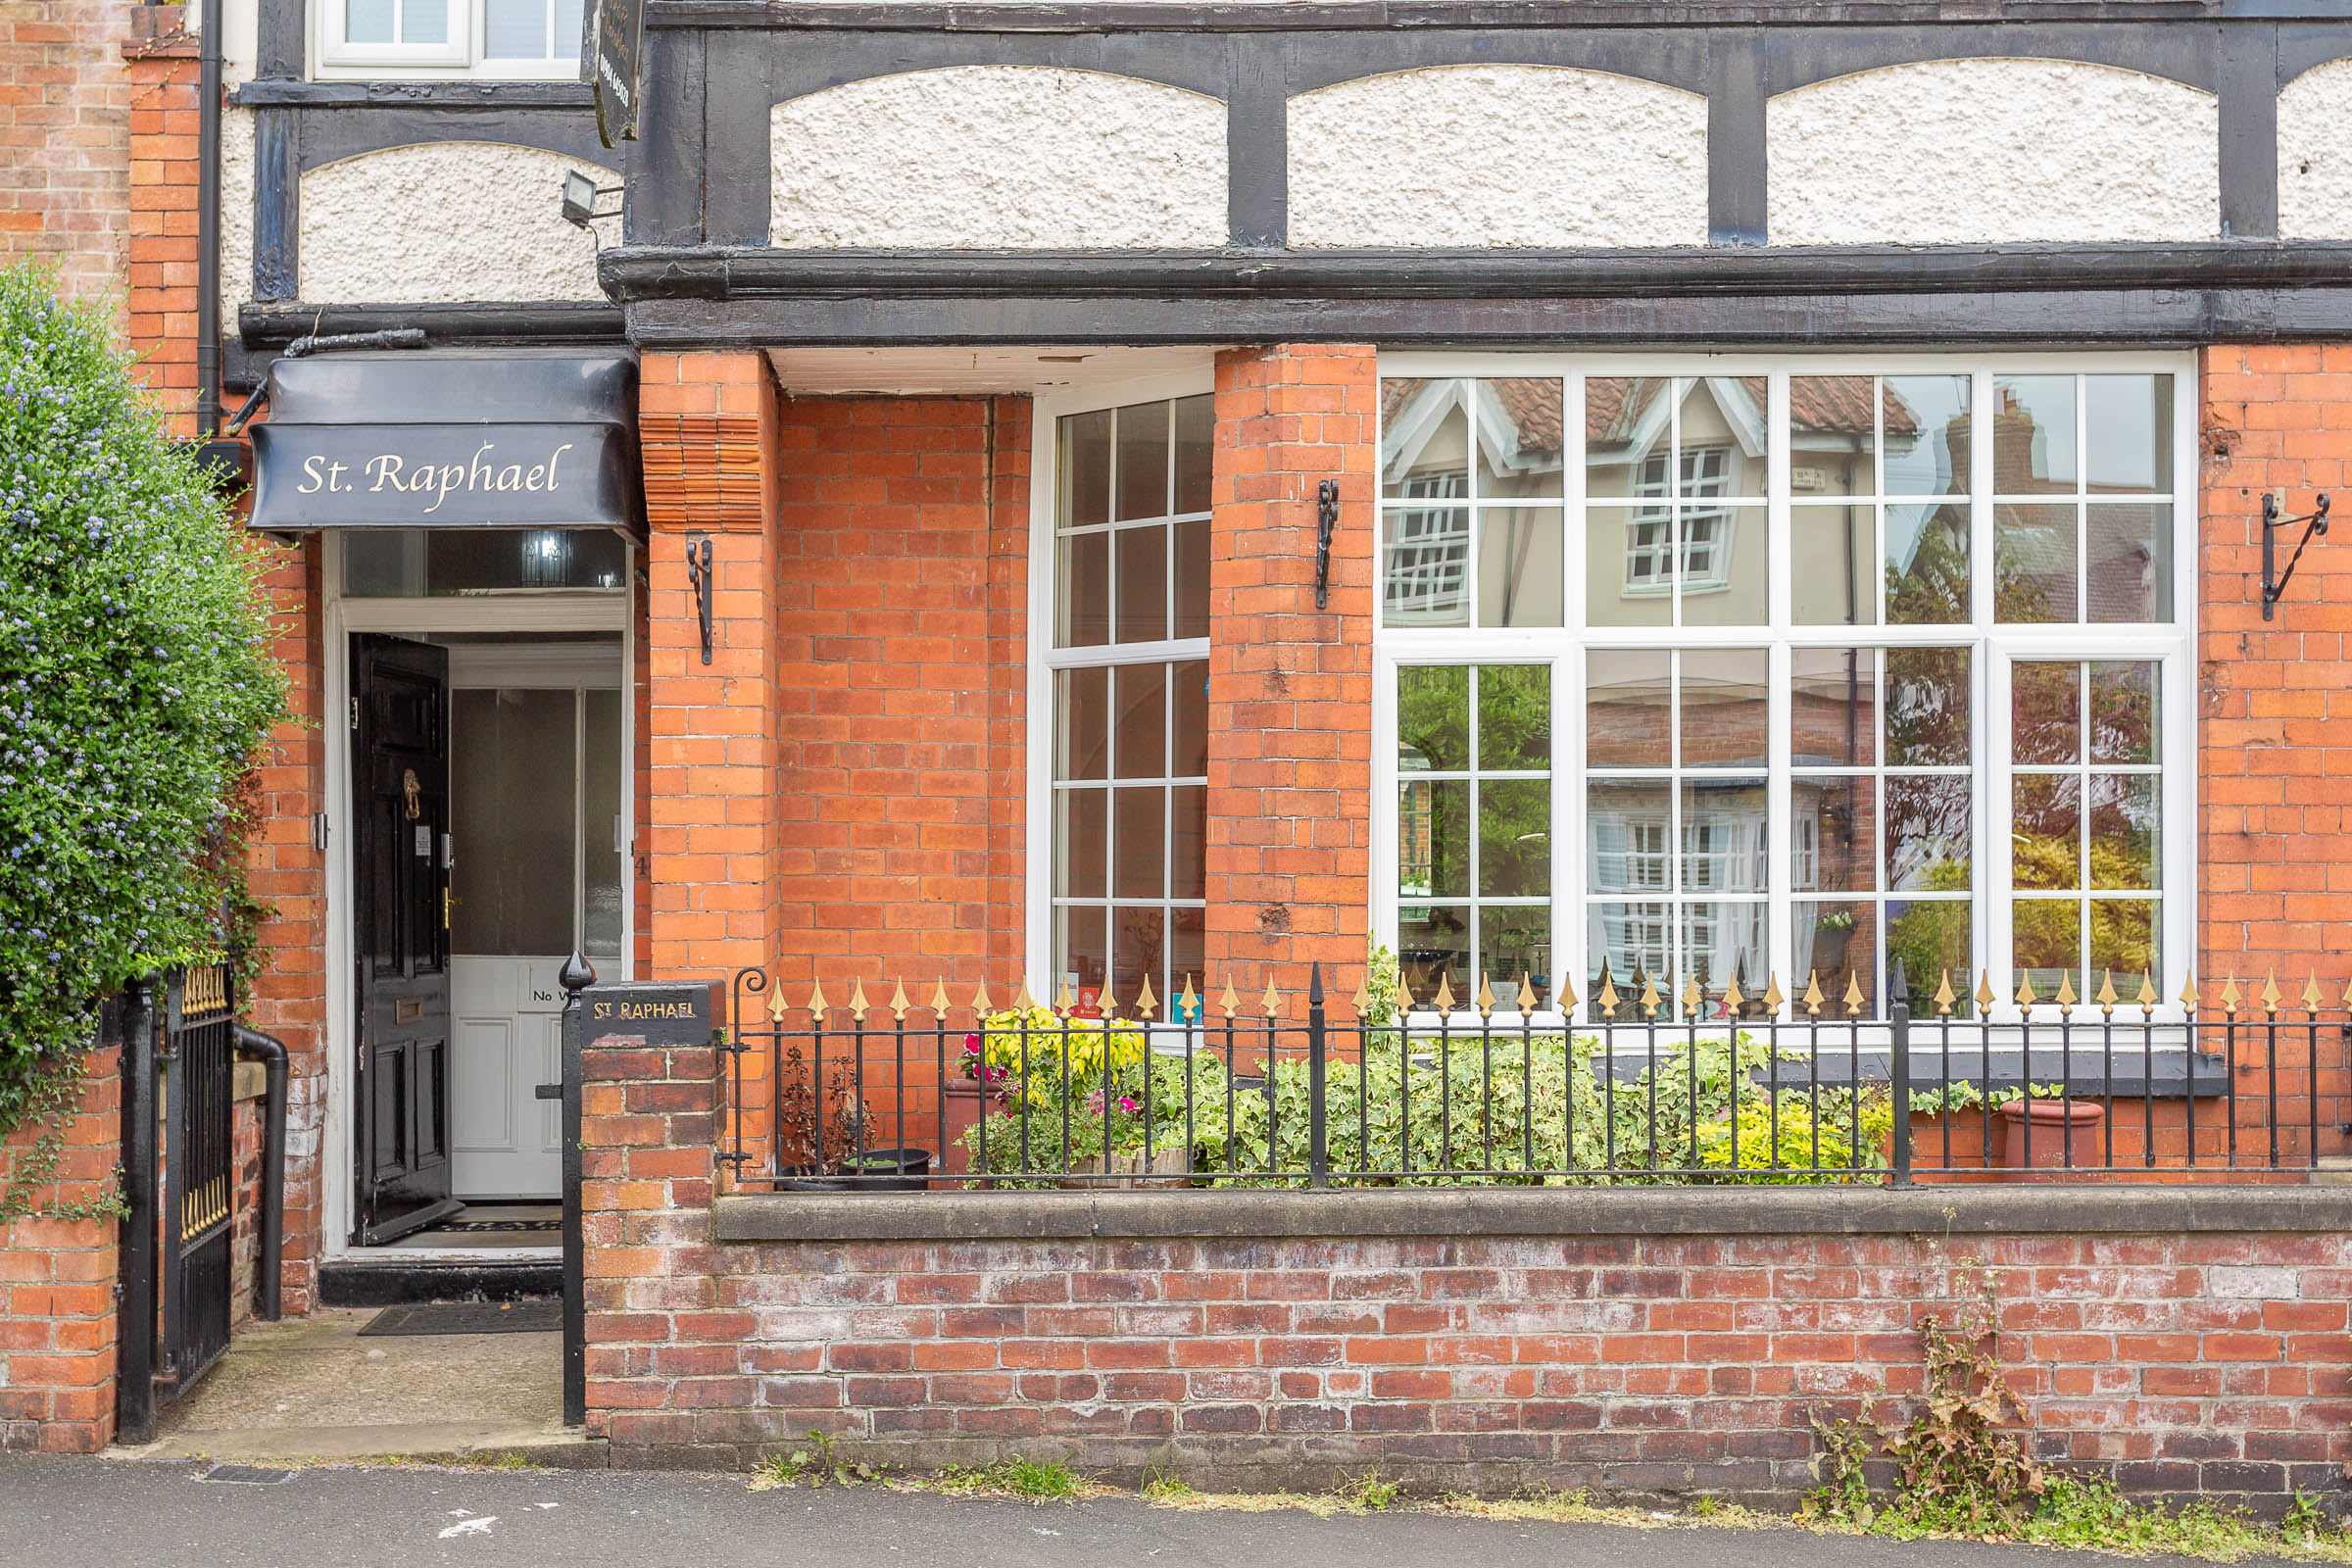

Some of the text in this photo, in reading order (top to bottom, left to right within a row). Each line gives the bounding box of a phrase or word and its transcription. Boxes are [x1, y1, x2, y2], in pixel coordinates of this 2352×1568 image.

[297, 443, 573, 514] St. Raphael
[533, 990, 553, 1002] No
[594, 1002, 698, 1019] ST RAPHAEL
